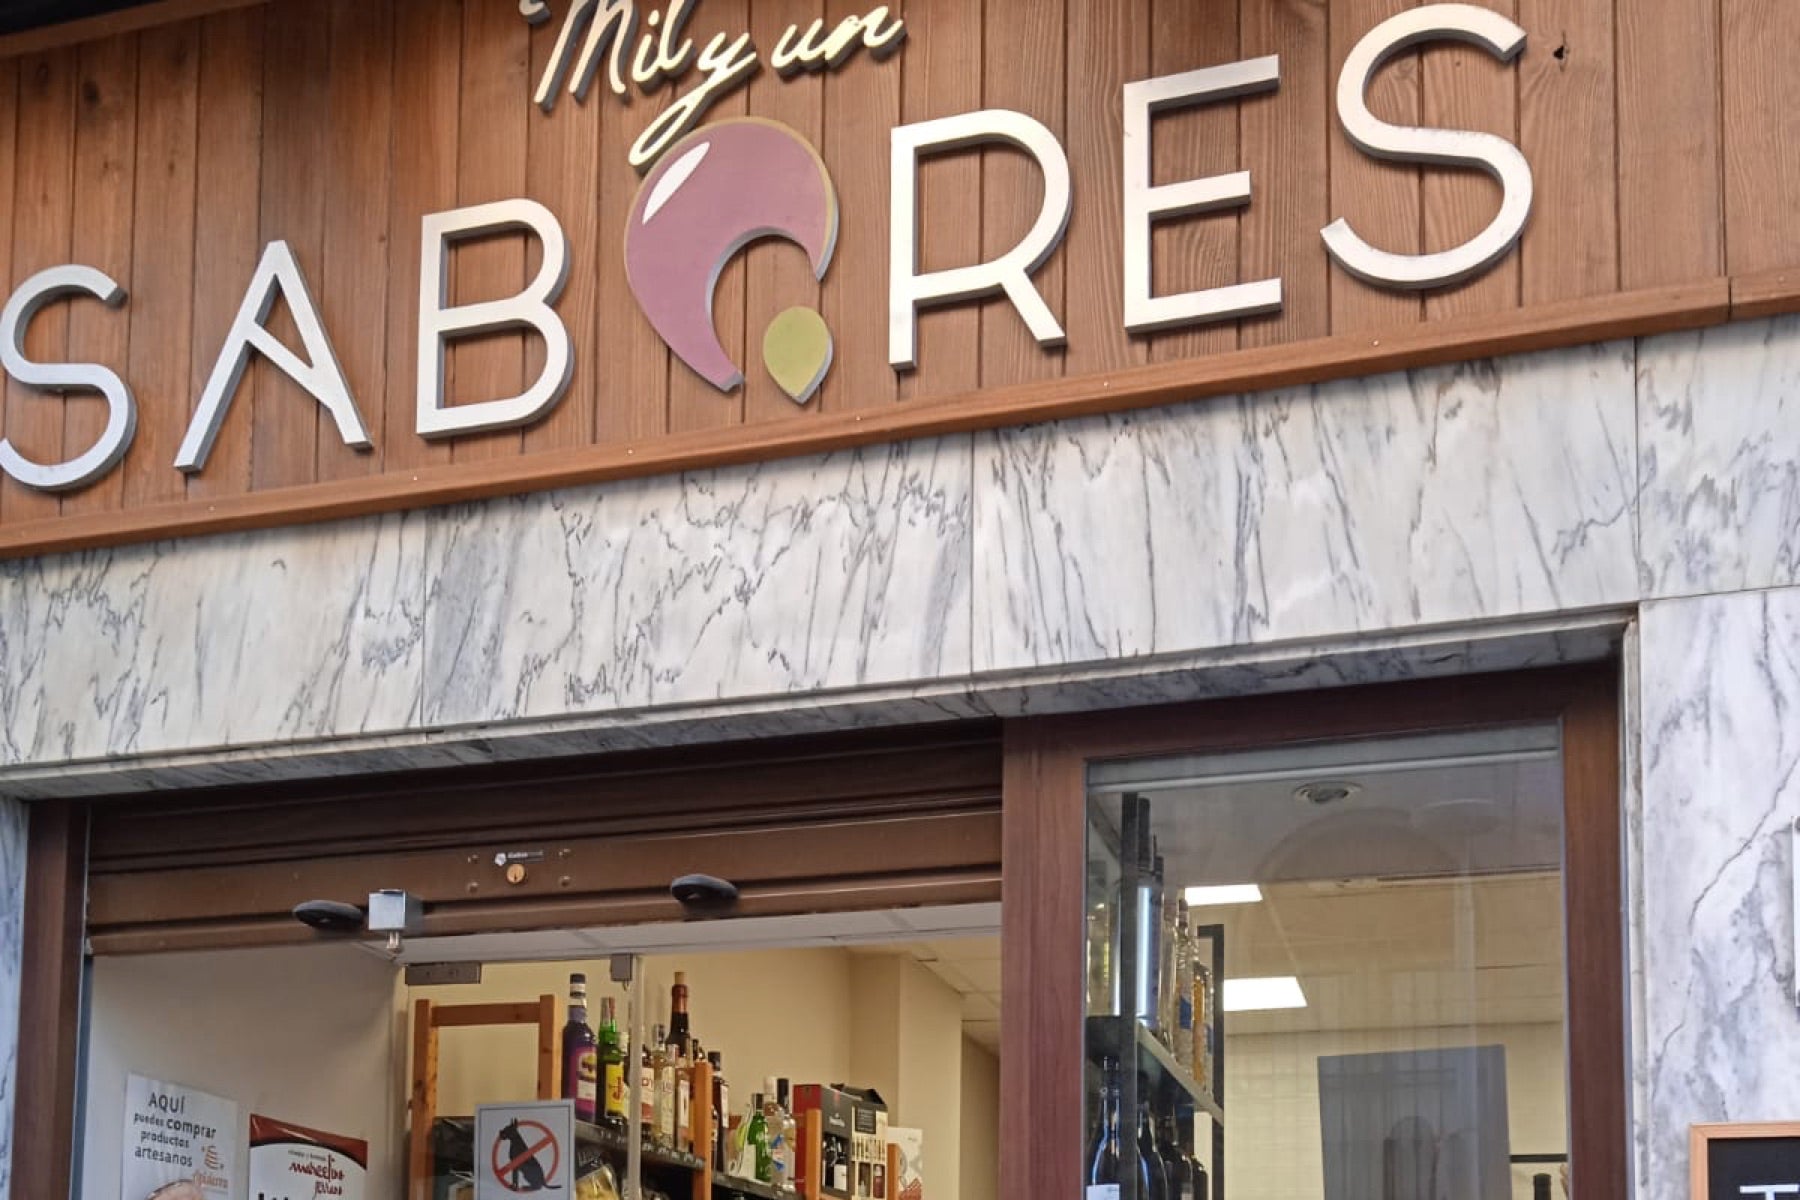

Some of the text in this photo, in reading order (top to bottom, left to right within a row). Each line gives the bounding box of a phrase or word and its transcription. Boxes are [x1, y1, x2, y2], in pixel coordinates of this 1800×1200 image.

[628, 32, 757, 166] y
[771, 6, 904, 68] un
[148, 1092, 185, 1114] AQUÍ
[133, 1112, 217, 1139] puedes comprar
[140, 1130, 190, 1149] productos
[134, 1145, 193, 1168] artesanos
